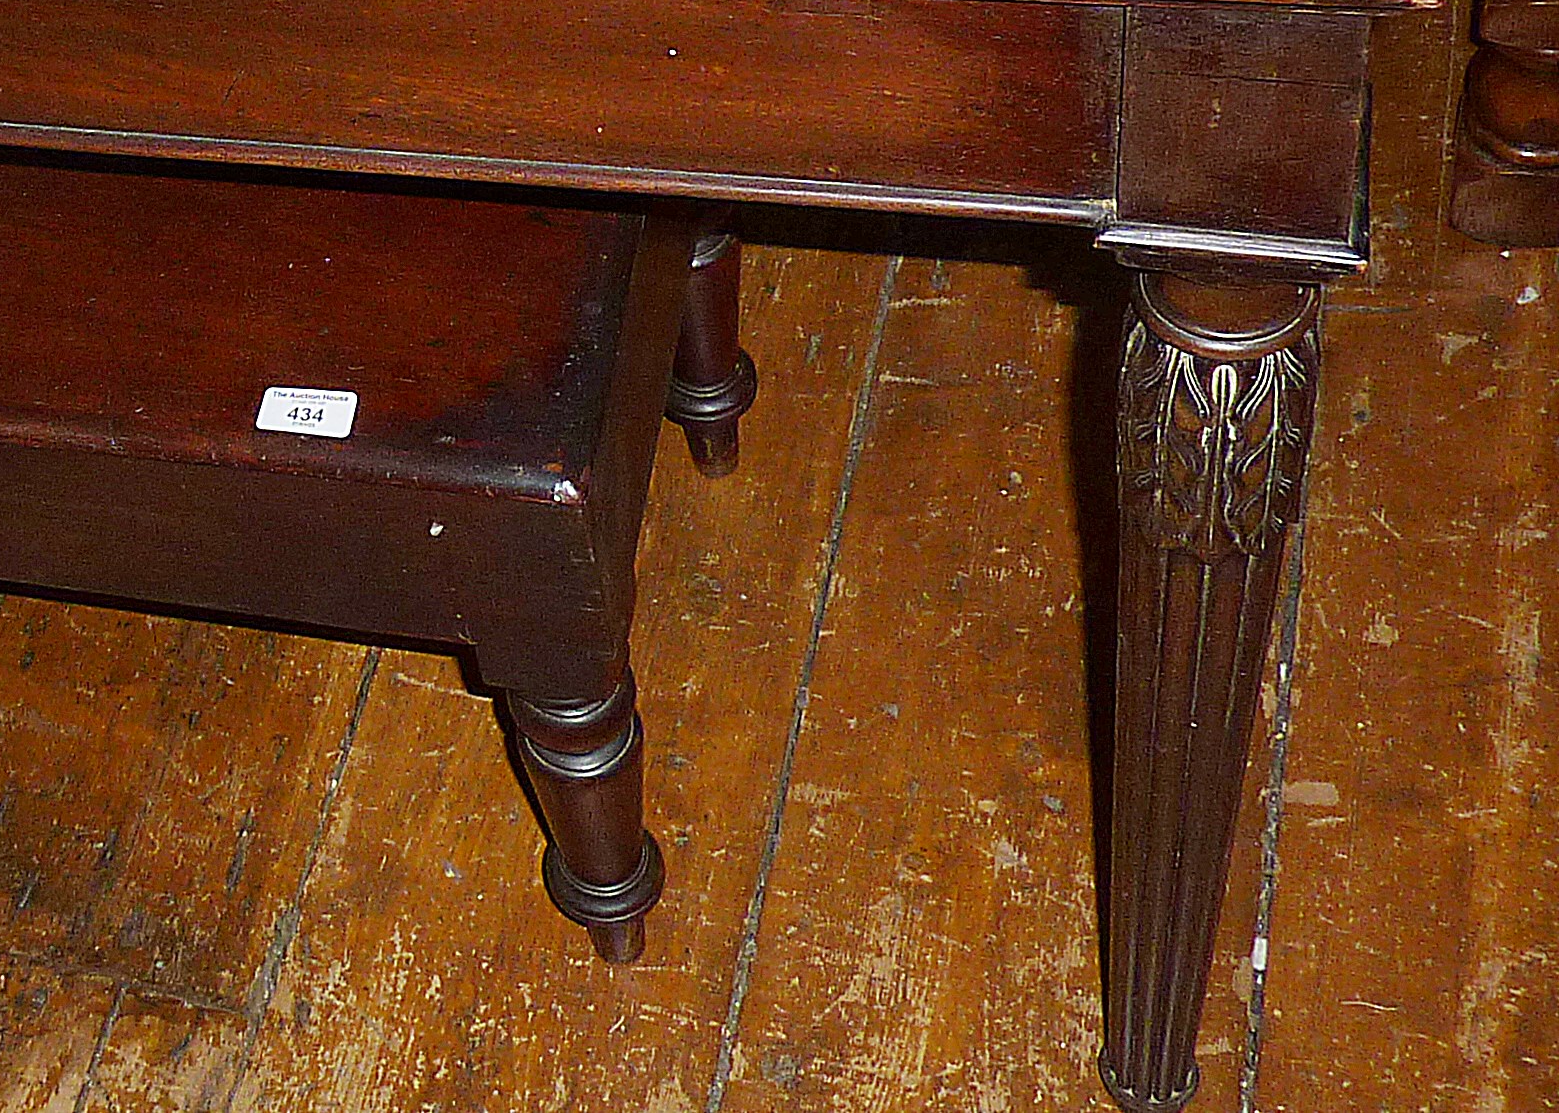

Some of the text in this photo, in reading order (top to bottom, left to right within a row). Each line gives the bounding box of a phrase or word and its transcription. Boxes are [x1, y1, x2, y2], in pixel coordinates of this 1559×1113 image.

[289, 392, 321, 400] Auction
[323, 394, 349, 402] House
[286, 407, 324, 423] 434
